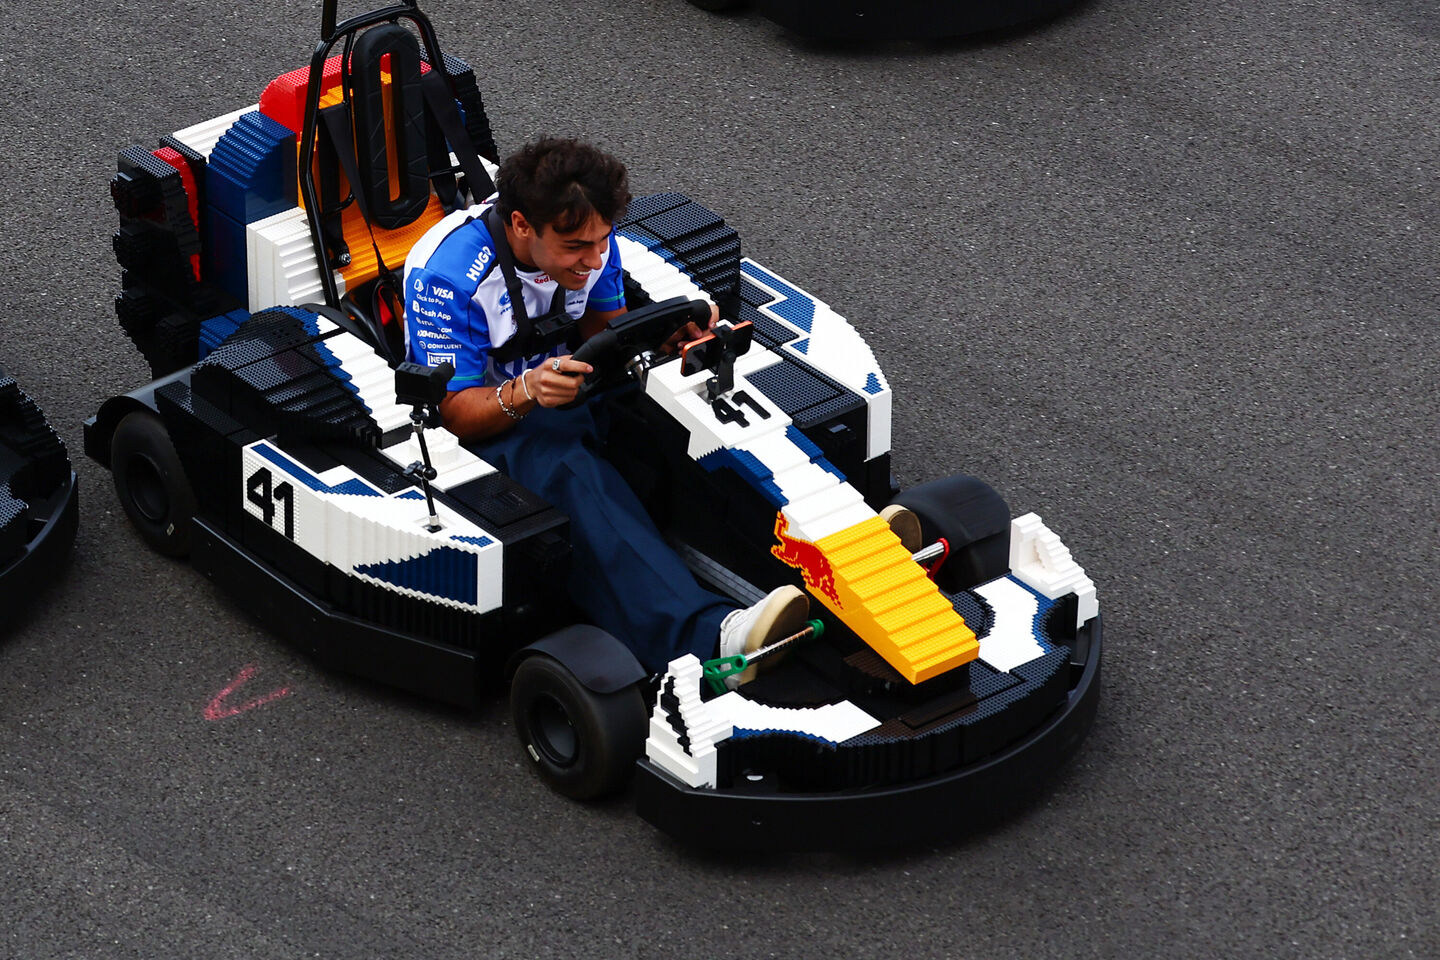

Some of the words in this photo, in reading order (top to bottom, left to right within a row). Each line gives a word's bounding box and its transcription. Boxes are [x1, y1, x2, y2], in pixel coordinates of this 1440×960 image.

[416, 293, 428, 302] Click
[435, 299, 445, 307] Pay
[432, 286, 454, 300] VISA
[420, 307, 436, 318] Cash
[437, 311, 451, 321] App
[711, 389, 772, 429] 41
[247, 466, 295, 542] 41
